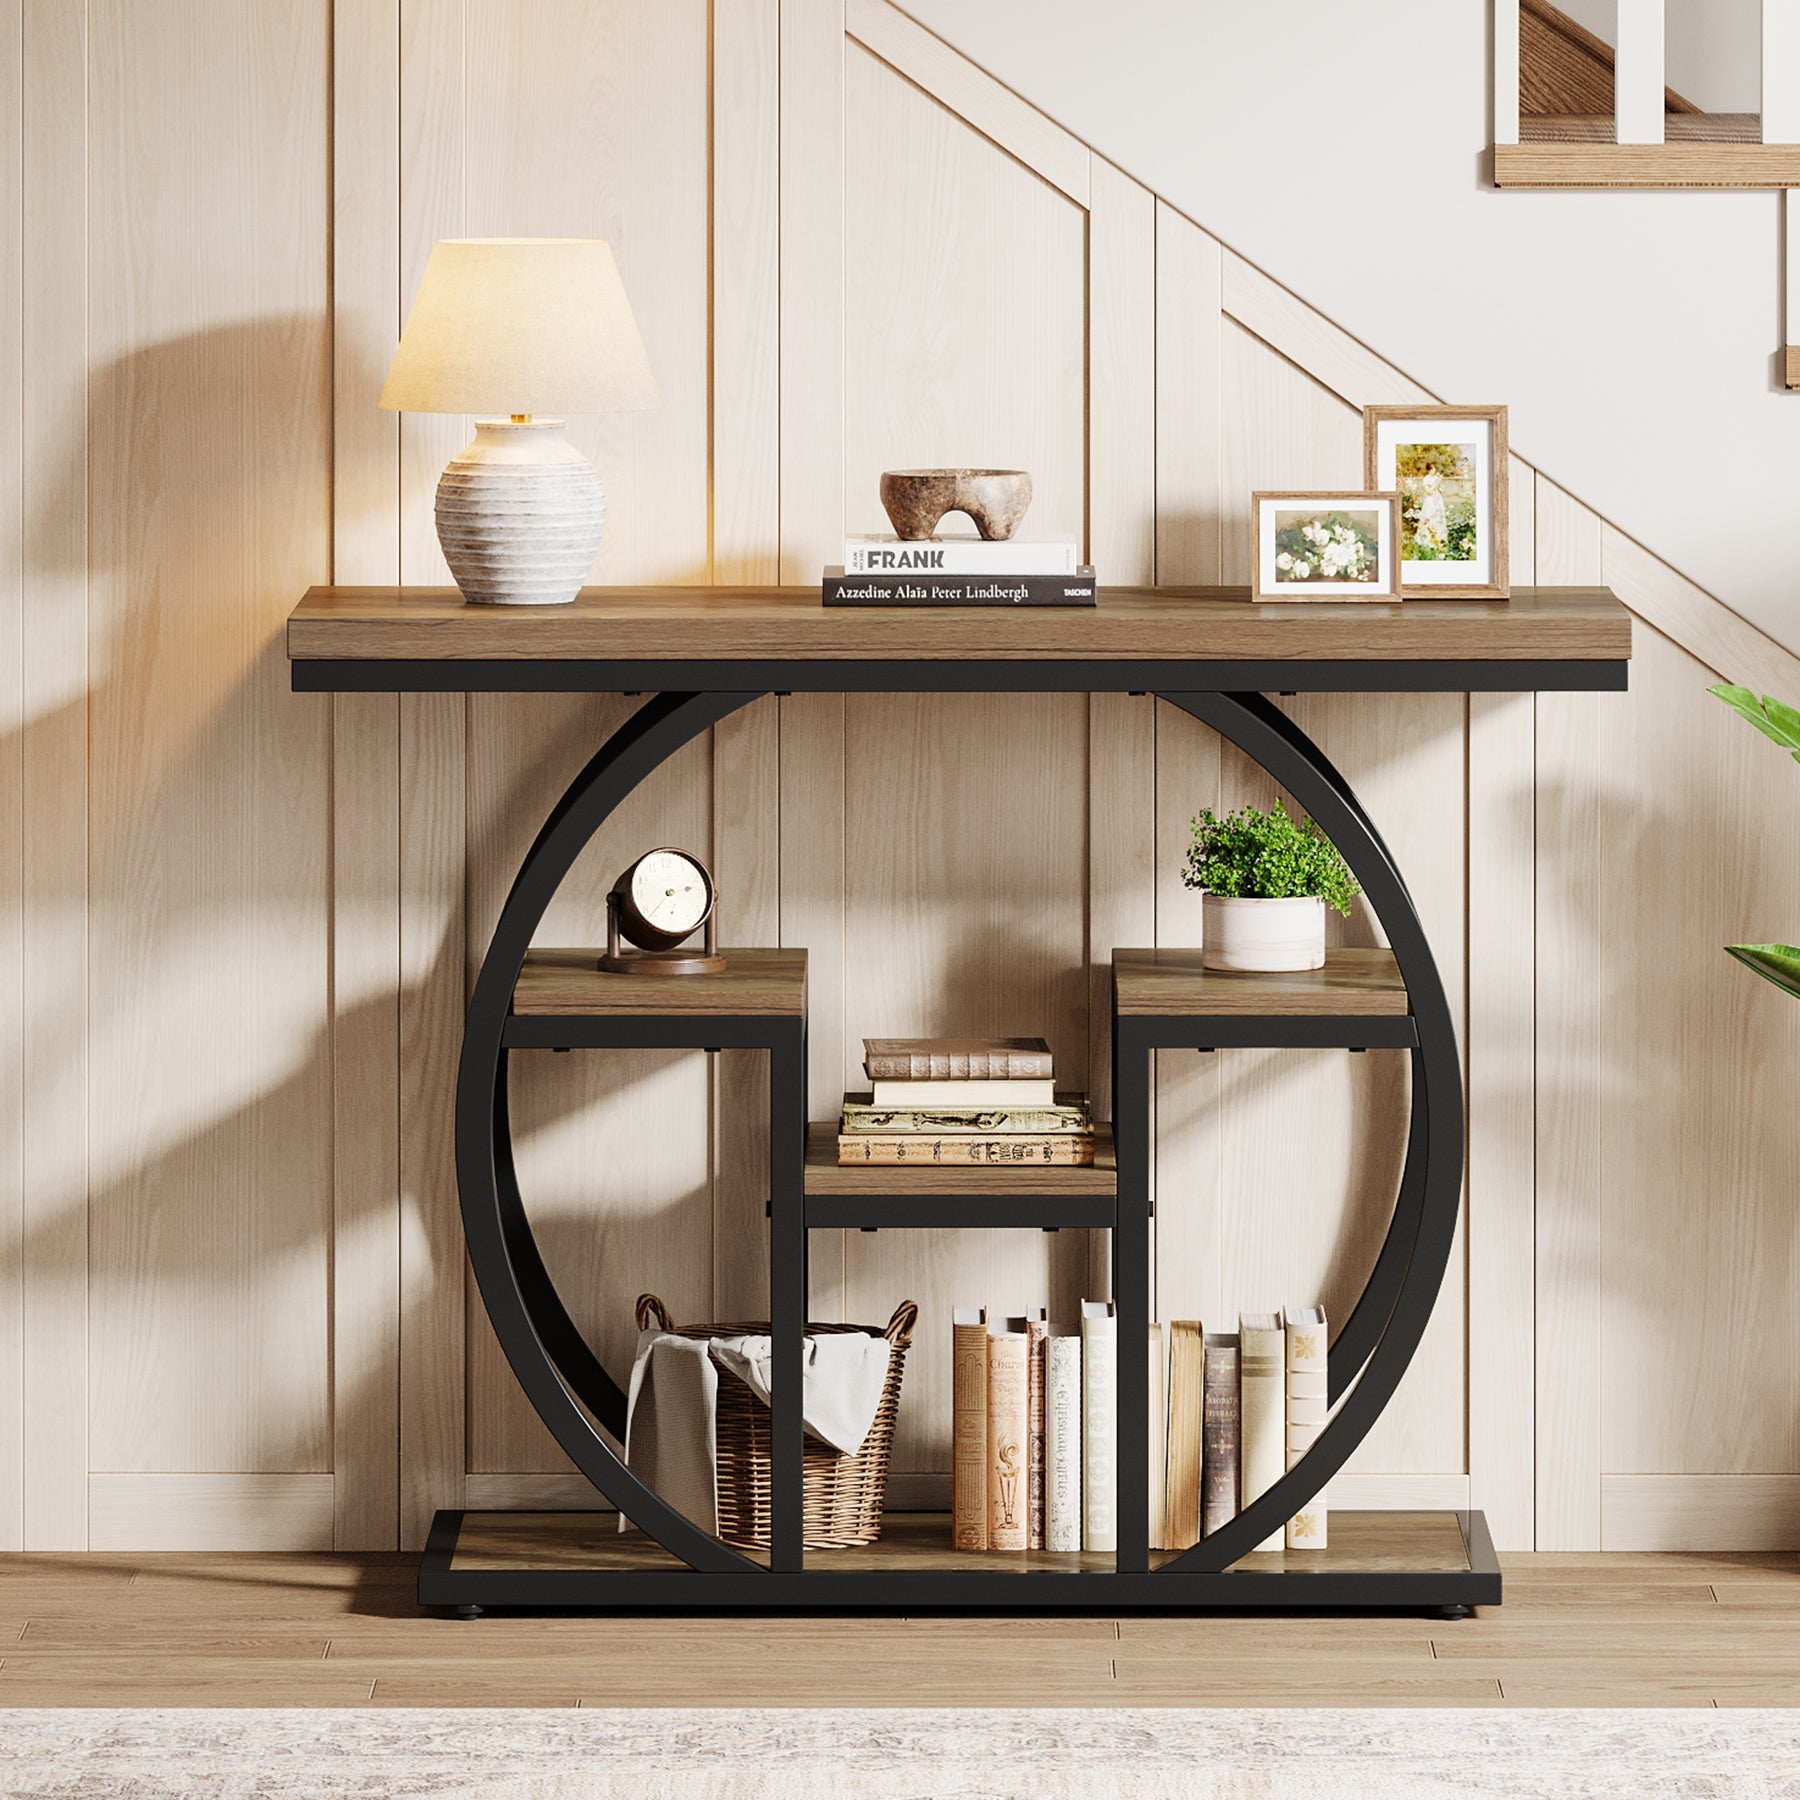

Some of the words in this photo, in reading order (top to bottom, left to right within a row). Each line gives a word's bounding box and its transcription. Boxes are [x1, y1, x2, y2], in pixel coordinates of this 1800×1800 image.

[866, 550, 945, 569] FRANK
[835, 584, 892, 599] Azzedine
[895, 585, 928, 599] Alaïa
[931, 586, 962, 599] Peter
[966, 584, 1029, 602] Lindbergh
[1063, 588, 1092, 597] TASCHEN
